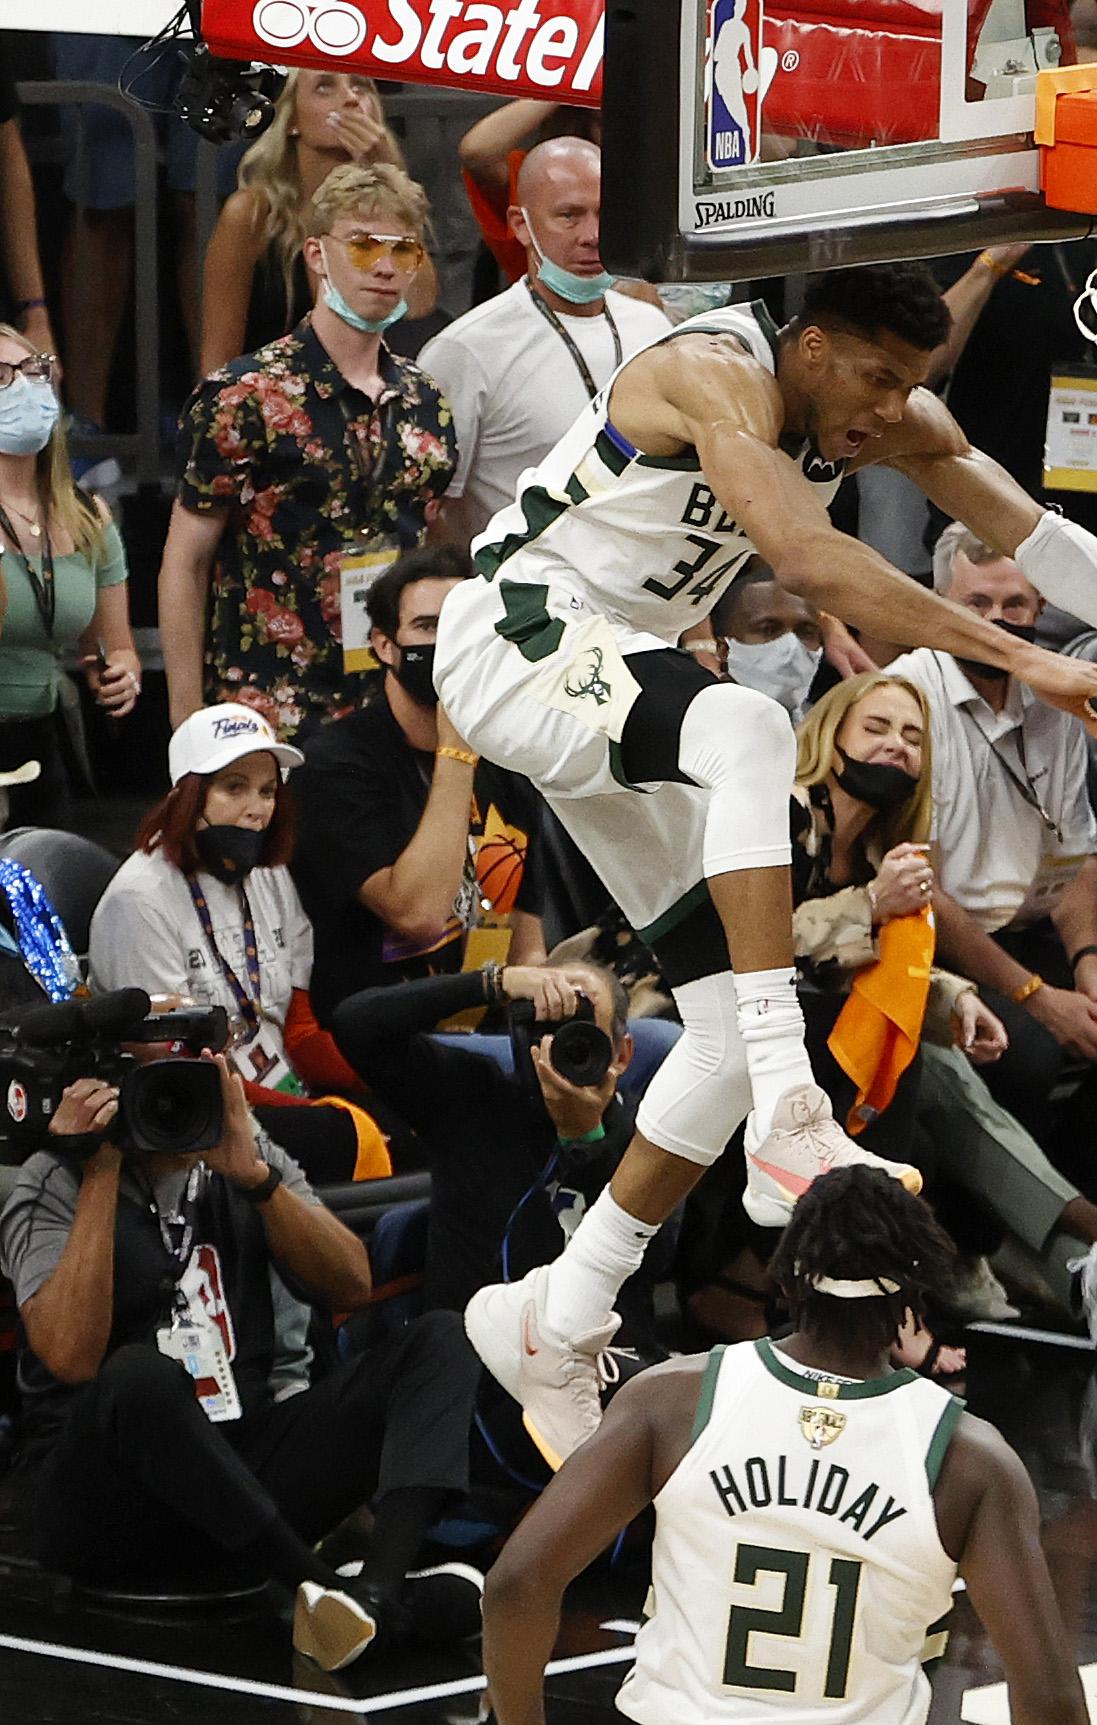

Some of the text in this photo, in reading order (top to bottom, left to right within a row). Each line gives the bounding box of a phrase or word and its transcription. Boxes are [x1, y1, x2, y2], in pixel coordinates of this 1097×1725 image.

[371, 0, 578, 86] State
[715, 130, 740, 160] NBA
[695, 192, 775, 229] SPALDING
[642, 534, 749, 606] 34
[710, 1455, 907, 1541] HOLIDAY
[723, 1543, 863, 1698] 21
